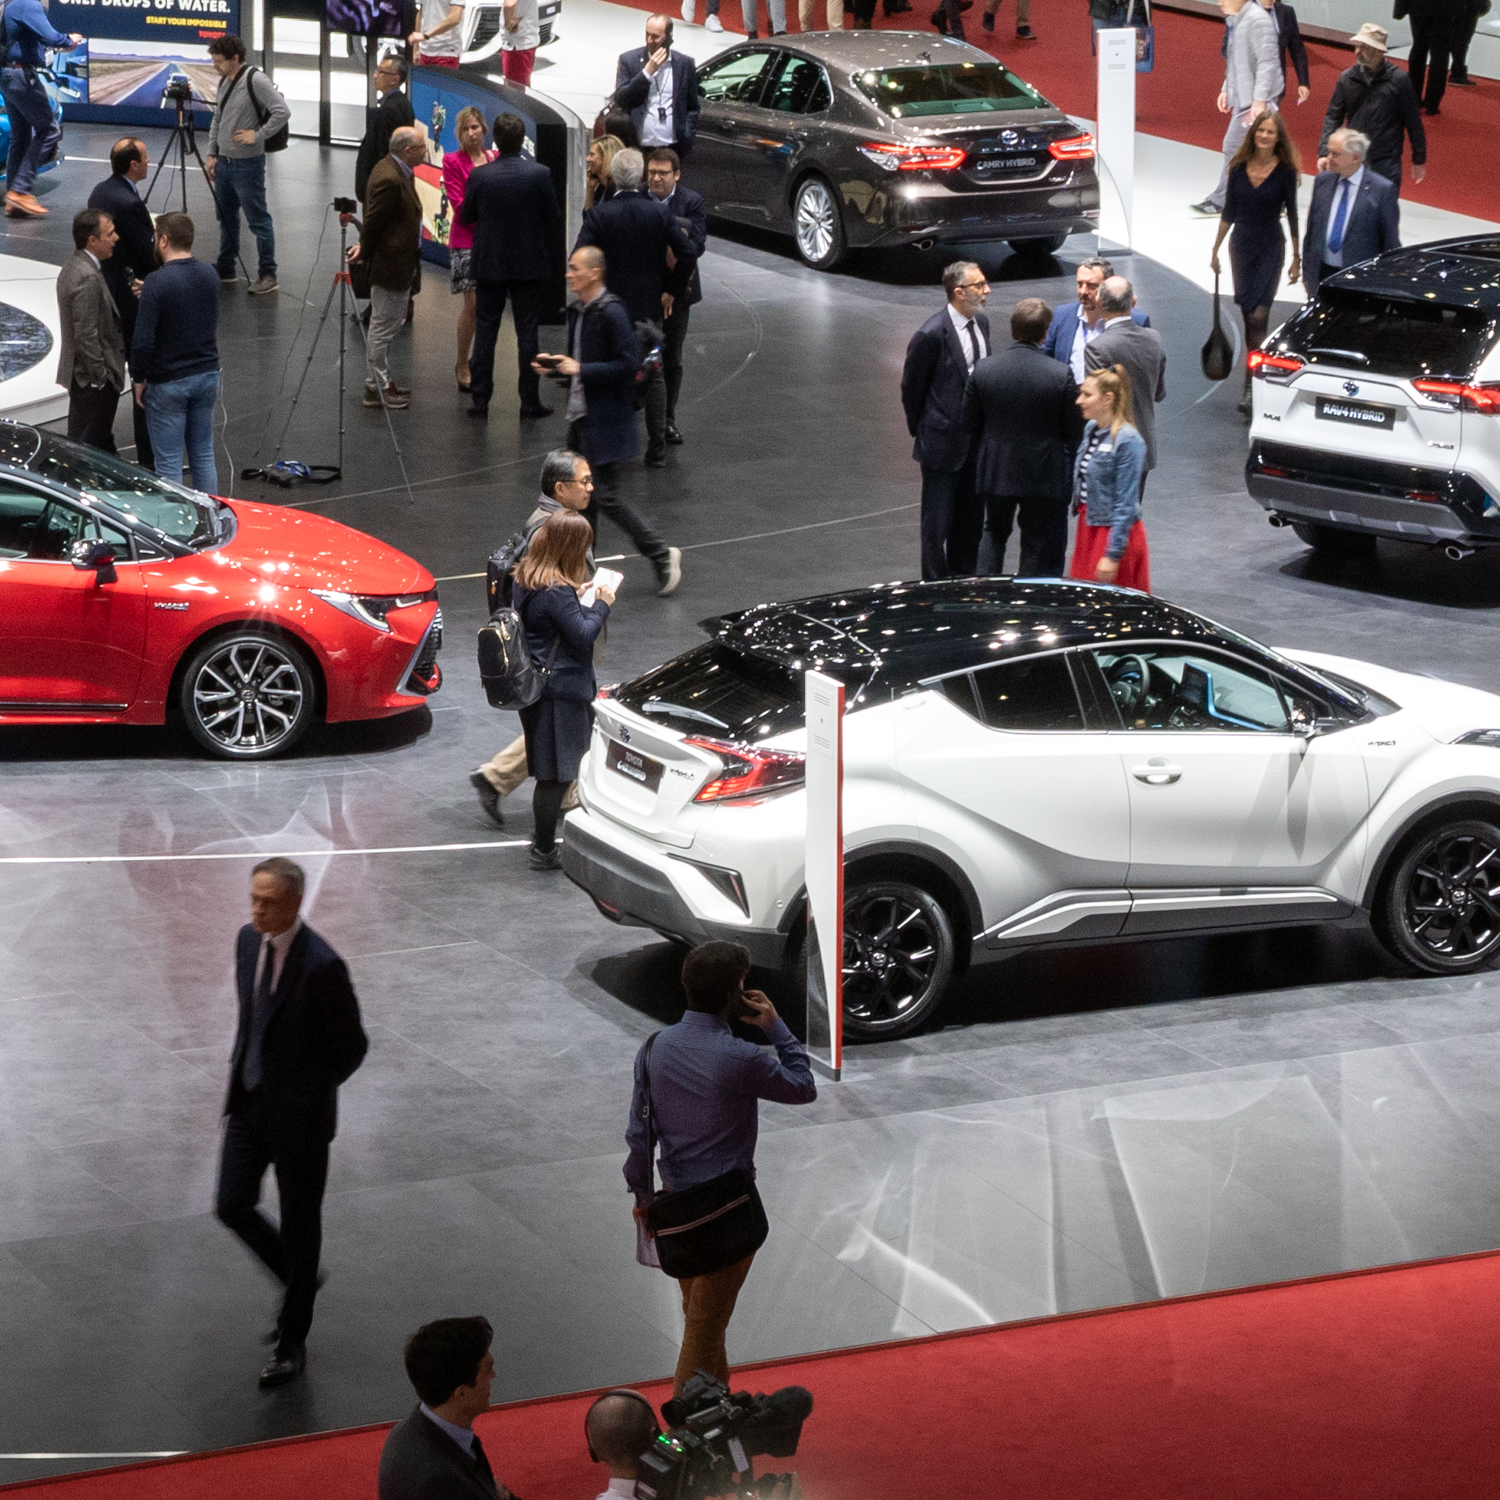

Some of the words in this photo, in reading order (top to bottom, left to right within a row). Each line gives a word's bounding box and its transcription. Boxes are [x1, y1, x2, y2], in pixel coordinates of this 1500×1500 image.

[145, 15, 167, 25] START
[167, 16, 186, 26] YOUR
[186, 17, 227, 29] IMPOSSIBLE
[976, 159, 1006, 171] CAMRY
[1006, 157, 1037, 169] HYBRID
[1323, 403, 1349, 417] RAV4
[1349, 406, 1386, 423] HYBRID
